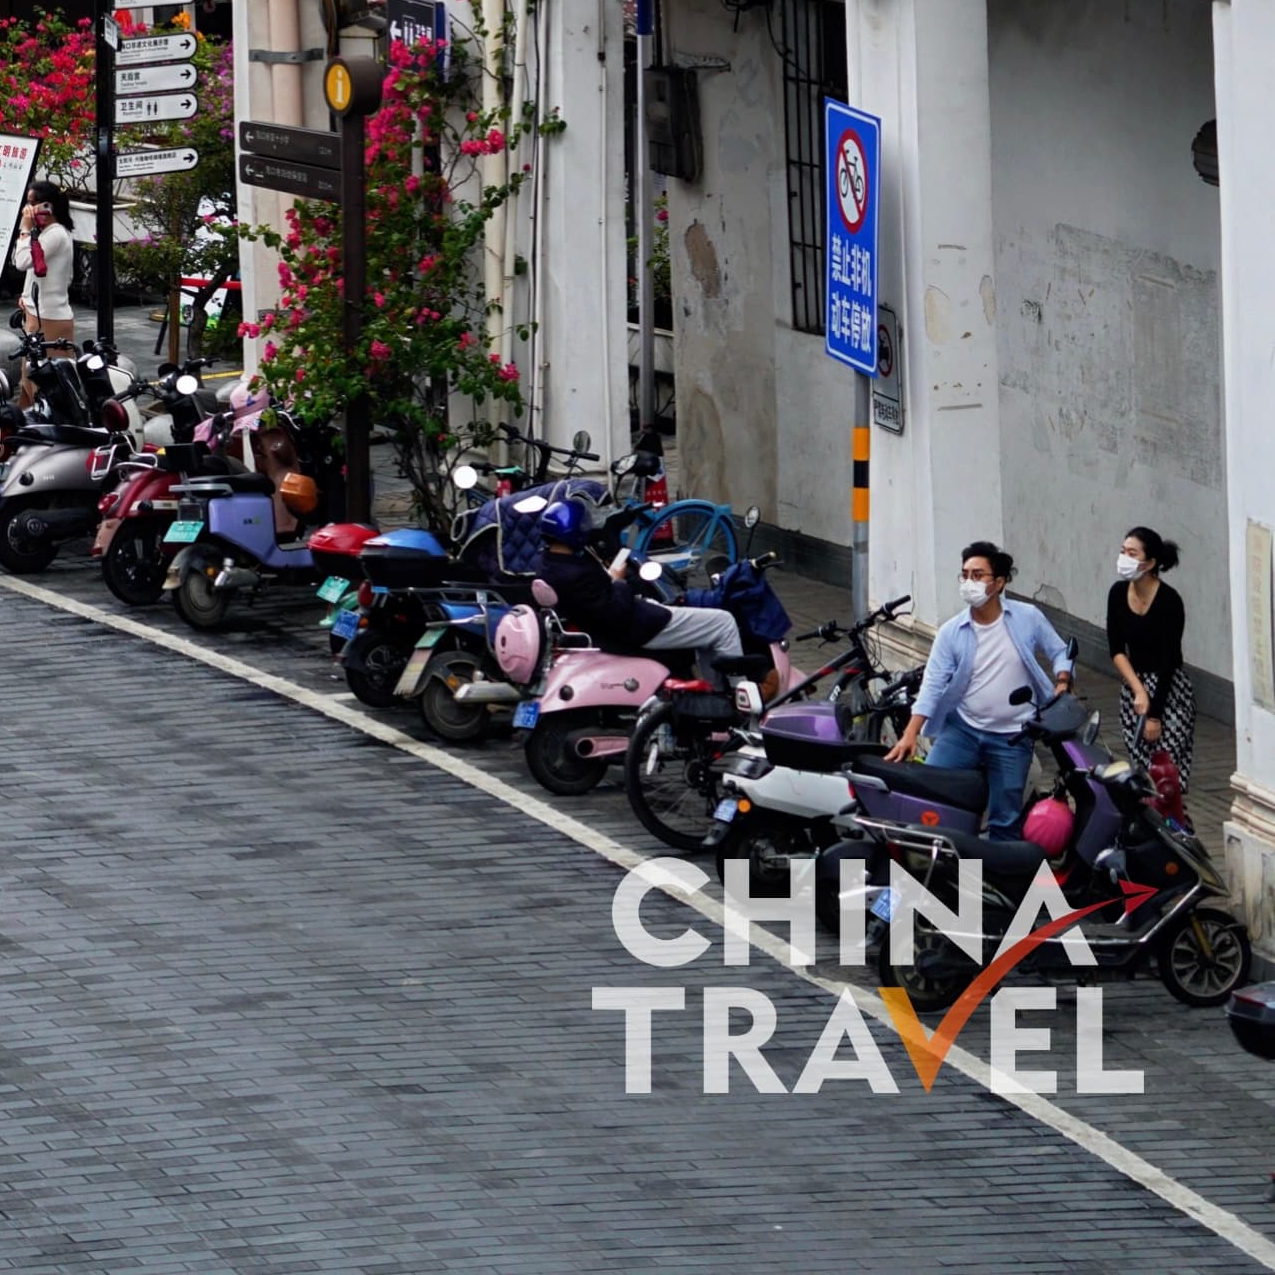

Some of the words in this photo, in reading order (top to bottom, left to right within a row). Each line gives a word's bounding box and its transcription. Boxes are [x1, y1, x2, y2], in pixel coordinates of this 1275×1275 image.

[120, 100, 143, 111] 卫生间
[831, 232, 872, 298] 禁止非机
[831, 290, 872, 355] 动车停放
